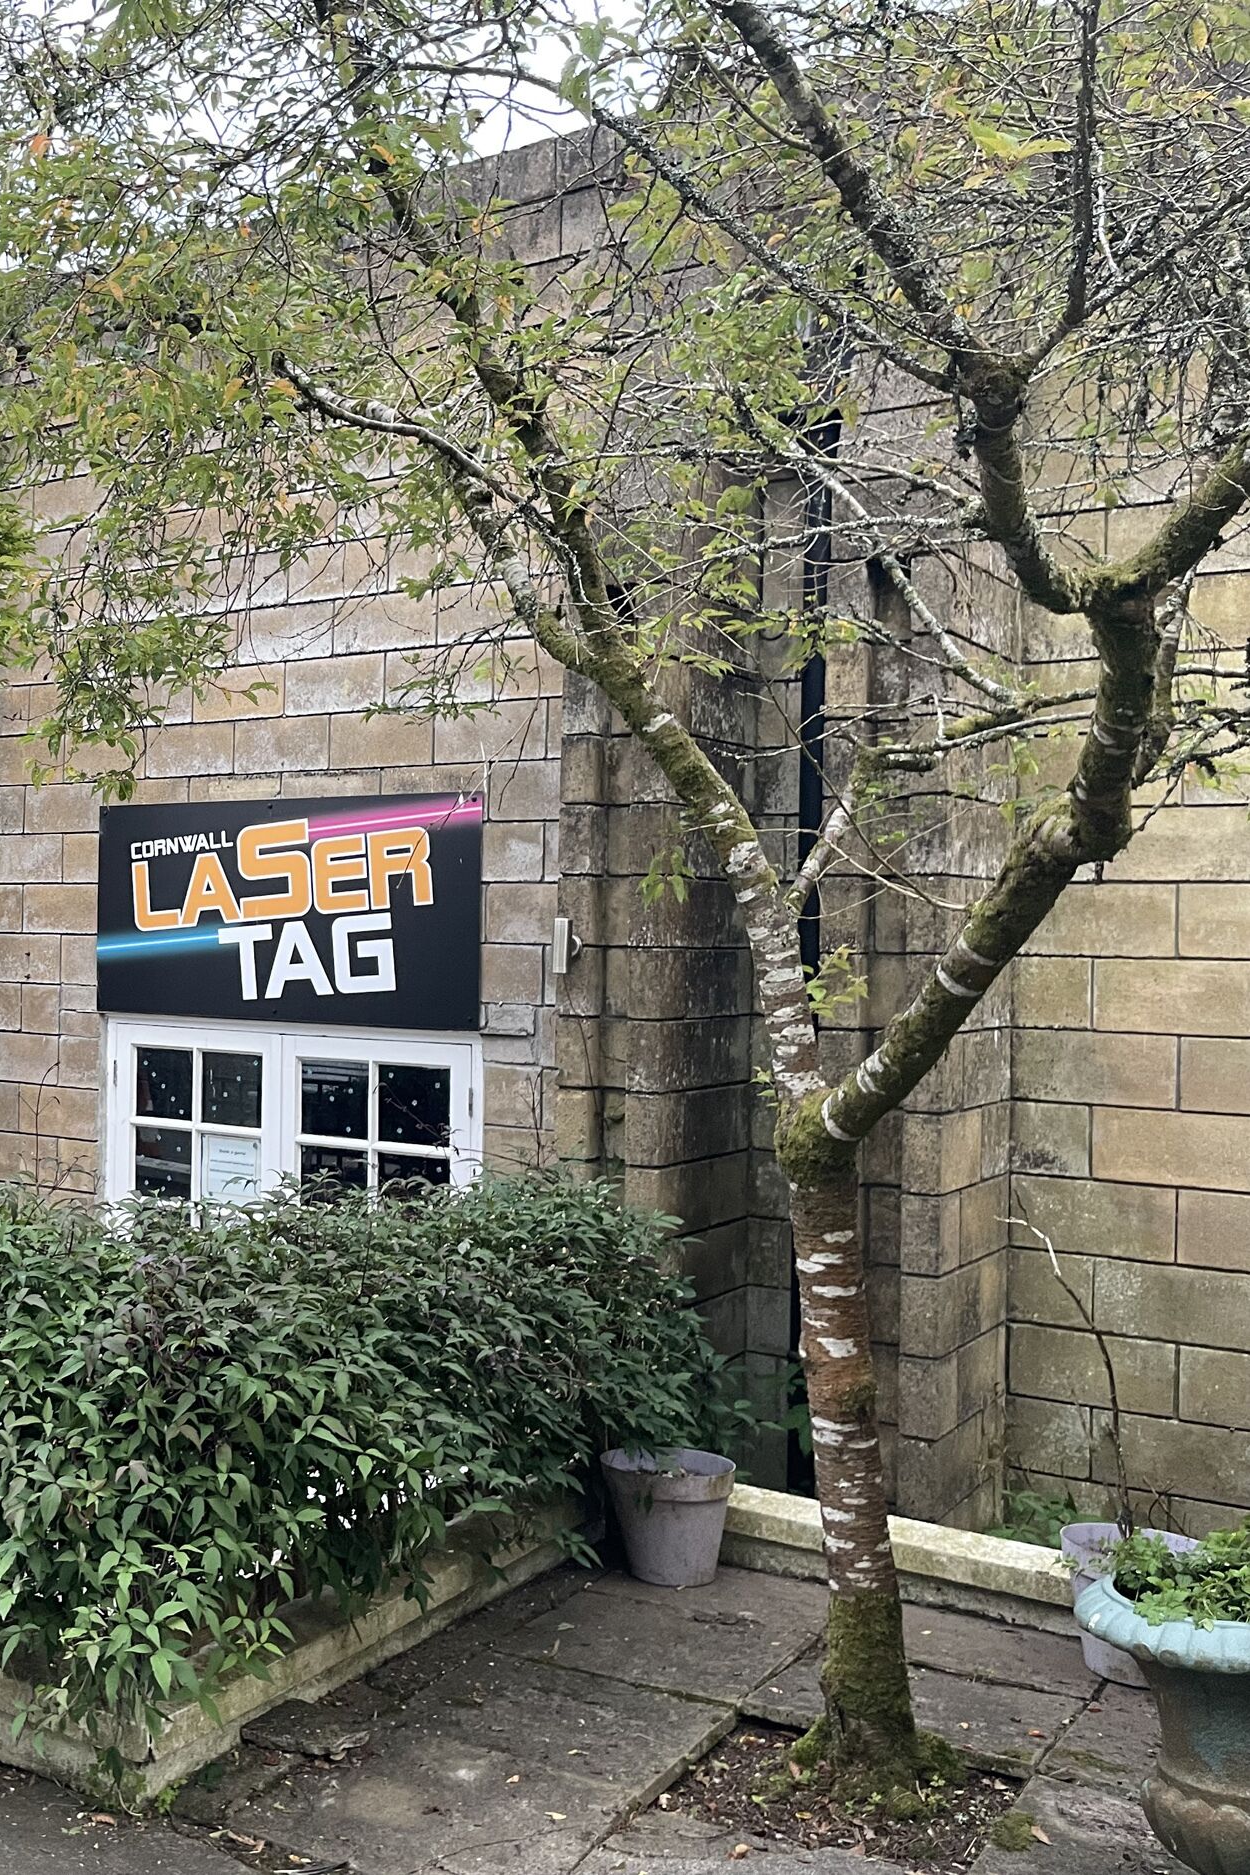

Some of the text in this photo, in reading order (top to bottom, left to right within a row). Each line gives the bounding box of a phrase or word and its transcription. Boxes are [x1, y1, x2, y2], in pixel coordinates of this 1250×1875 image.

[131, 831, 233, 859] CORNWALL
[131, 818, 434, 931] LASER
[218, 912, 396, 1000] TAG
